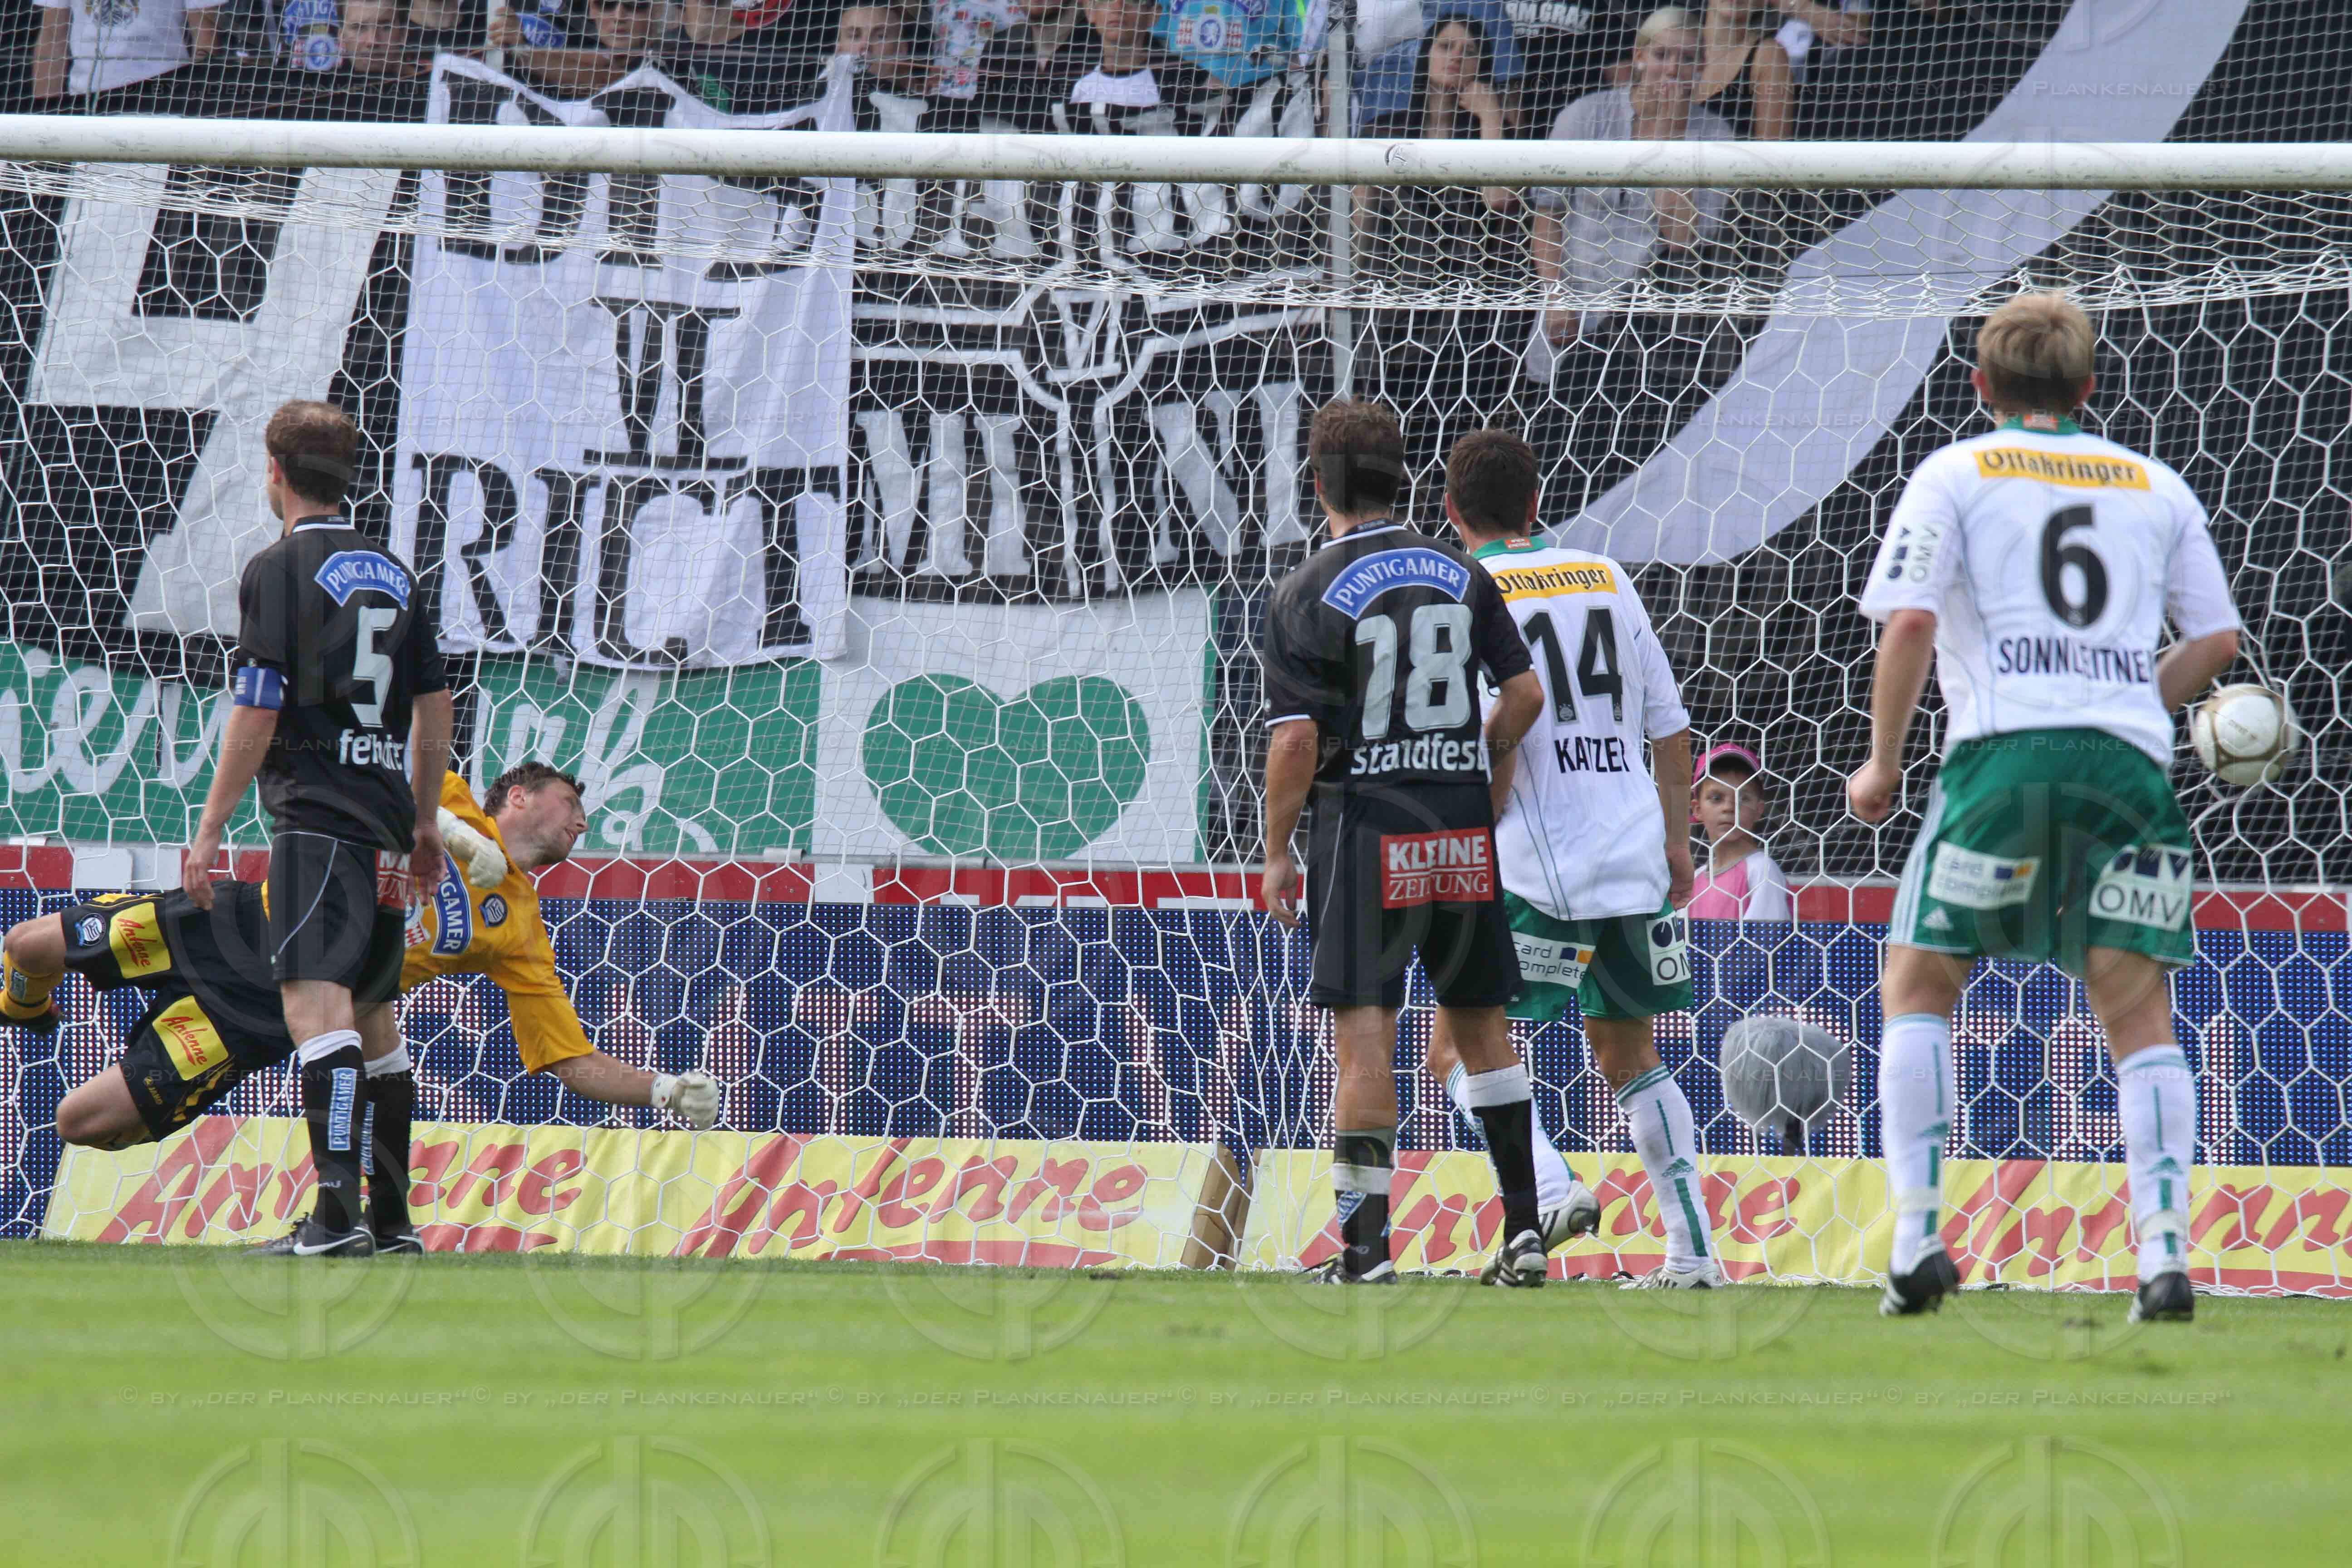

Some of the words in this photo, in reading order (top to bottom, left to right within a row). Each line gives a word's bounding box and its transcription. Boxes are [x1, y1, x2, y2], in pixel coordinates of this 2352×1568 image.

[1984, 451, 2134, 485] Ottakringer
[1335, 558, 1460, 607] PUNTIGAMER
[1494, 568, 1607, 595] Ottakringer
[2040, 504, 2109, 630] 6
[350, 605, 398, 728] 5
[1355, 603, 1473, 740] 18
[1520, 606, 1623, 725] 14
[1999, 636, 2153, 682] SONNLEITNE
[1389, 835, 1487, 871] KLEINE
[1389, 872, 1489, 901] ZEITUNG
[2098, 883, 2183, 922] OMV
[117, 917, 152, 967] Antenne
[161, 1015, 208, 1065] Antenne
[332, 1072, 353, 1146] PUNTIGAMER
[669, 1132, 1149, 1259] Antenne
